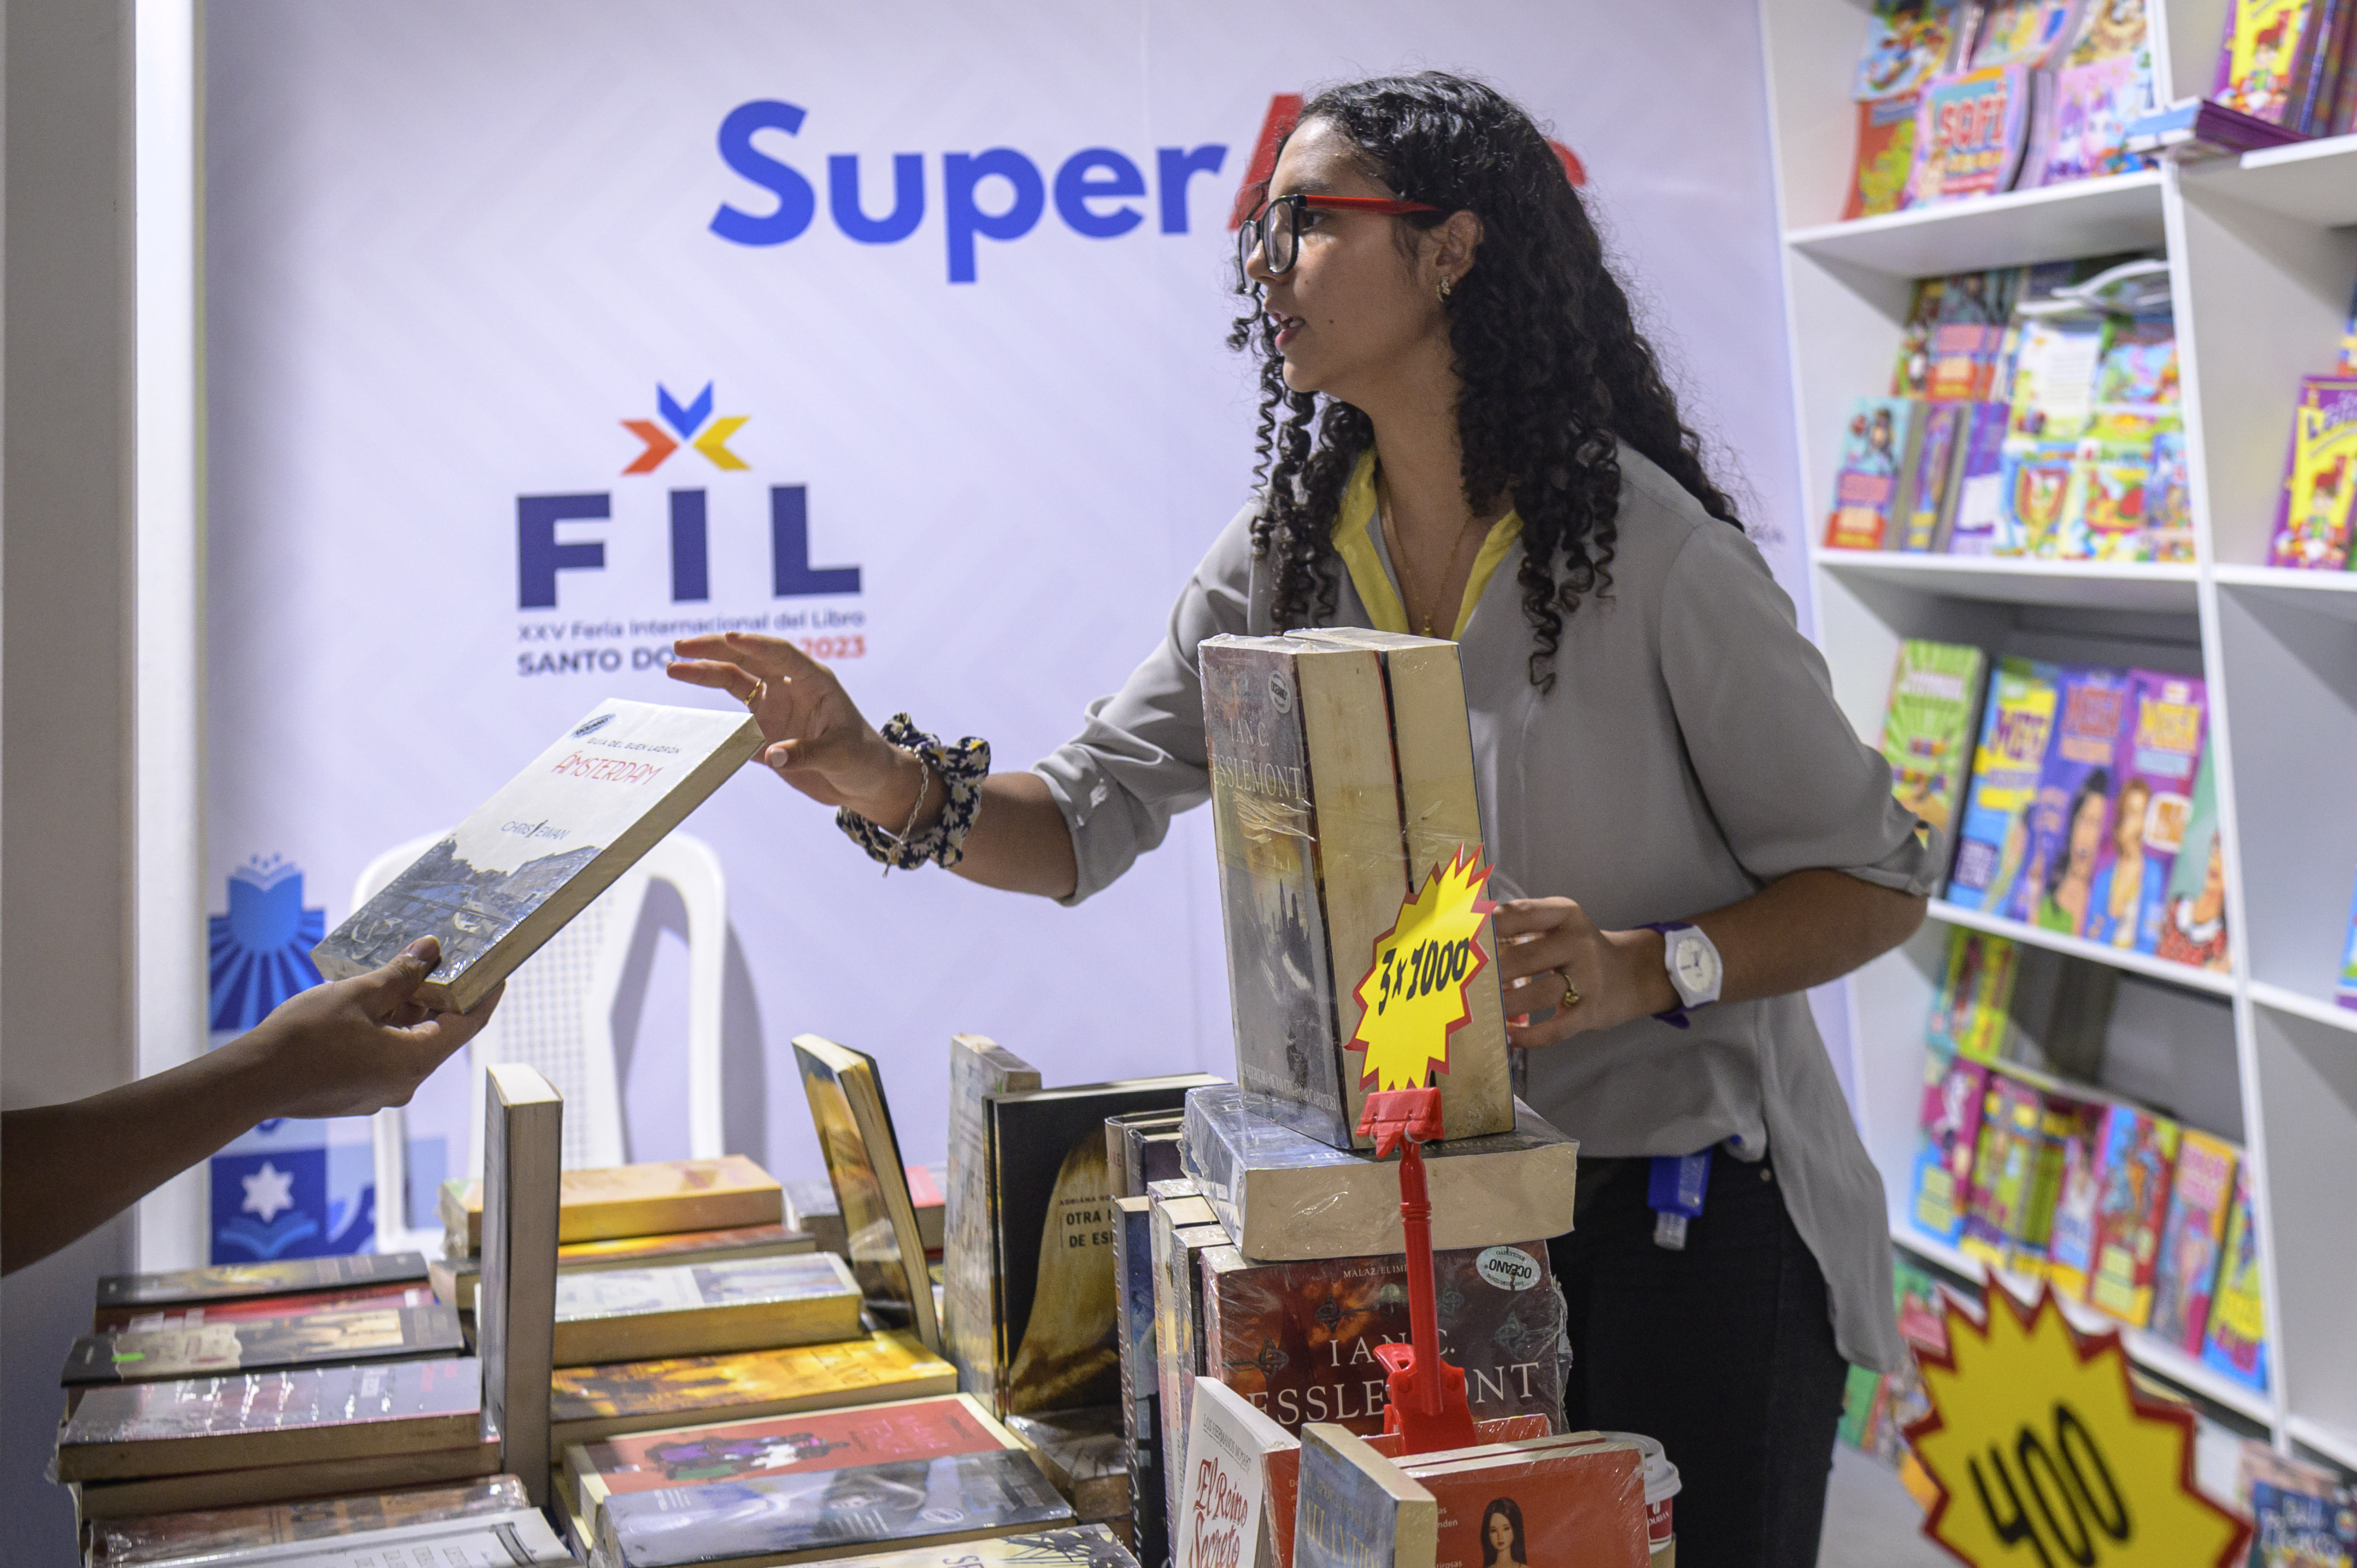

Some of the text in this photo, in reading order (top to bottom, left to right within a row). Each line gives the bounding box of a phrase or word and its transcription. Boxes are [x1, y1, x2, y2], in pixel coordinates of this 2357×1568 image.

[517, 484, 862, 609] FIL
[519, 608, 865, 641] XXV Feria Internacional del Libro
[517, 646, 622, 676] SANTO
[799, 634, 867, 659] 2023
[1229, 717, 1269, 746] IAN C.
[551, 750, 664, 785] ÁMSTERDAM
[1066, 1210, 1102, 1225] OTRA
[1069, 1233, 1086, 1248] DE
[1488, 1258, 1533, 1279] OCEANO
[1246, 1362, 1539, 1426] ESSLENT
[1203, 1413, 1212, 1432] LOS
[1212, 1421, 1235, 1454] HERMANOS
[1193, 1457, 1218, 1516] El
[1212, 1472, 1248, 1528] Reino
[1967, 1402, 2130, 1568] 400
[1187, 1511, 1240, 1568] Secreto
